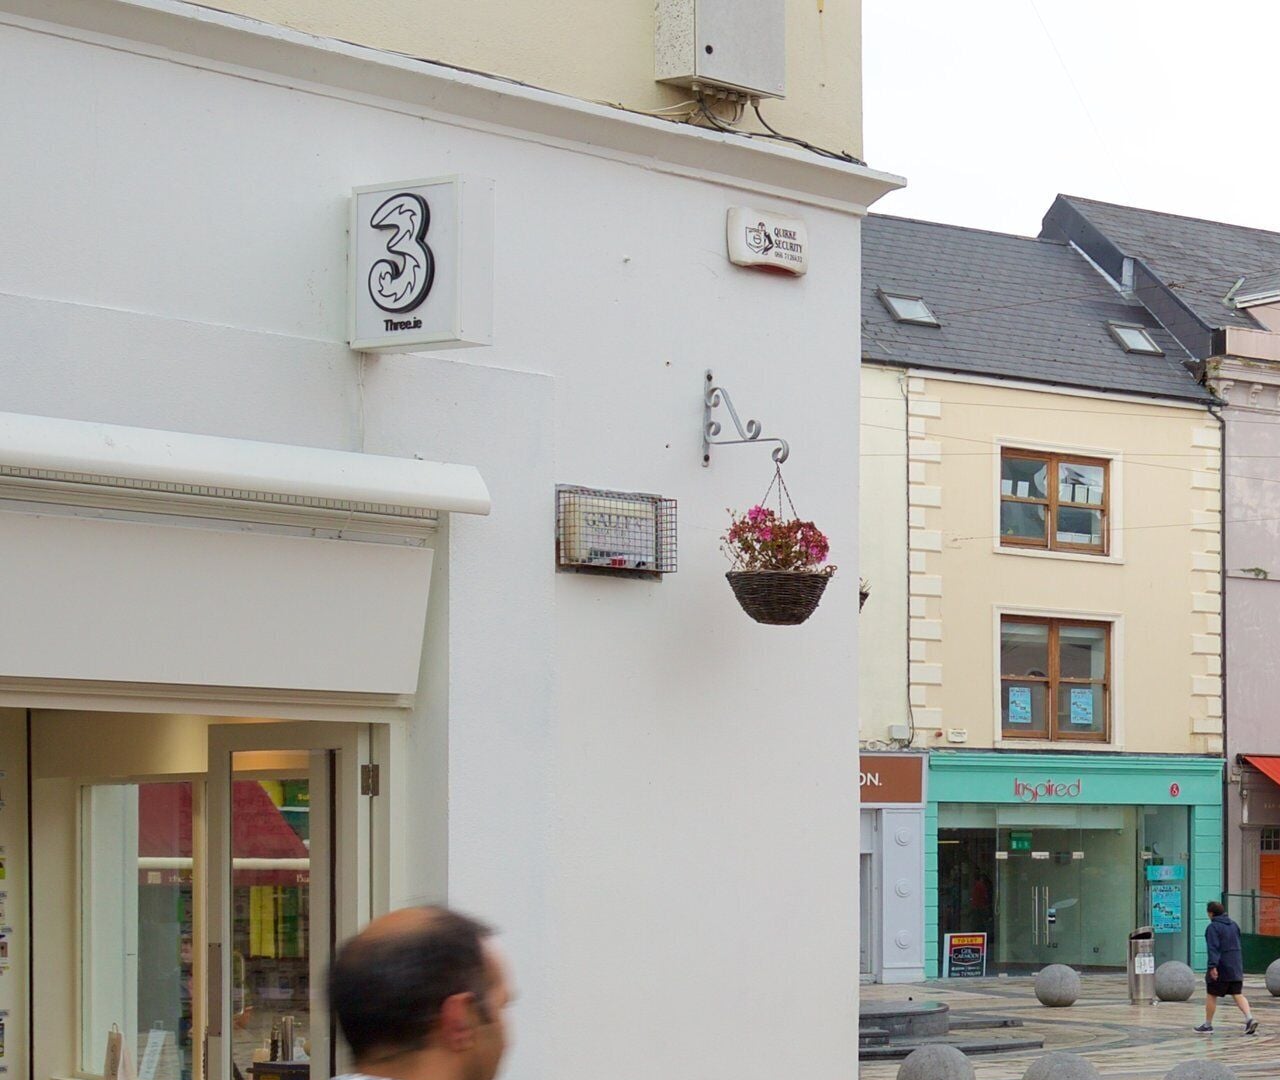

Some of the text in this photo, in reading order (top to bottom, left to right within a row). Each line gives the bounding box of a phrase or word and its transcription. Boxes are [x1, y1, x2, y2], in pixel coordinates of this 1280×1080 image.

[368, 193, 435, 314] 3
[774, 239, 802, 253] SECURITY
[384, 317, 422, 331] Three.ie
[1014, 777, 1081, 801] Inspired
